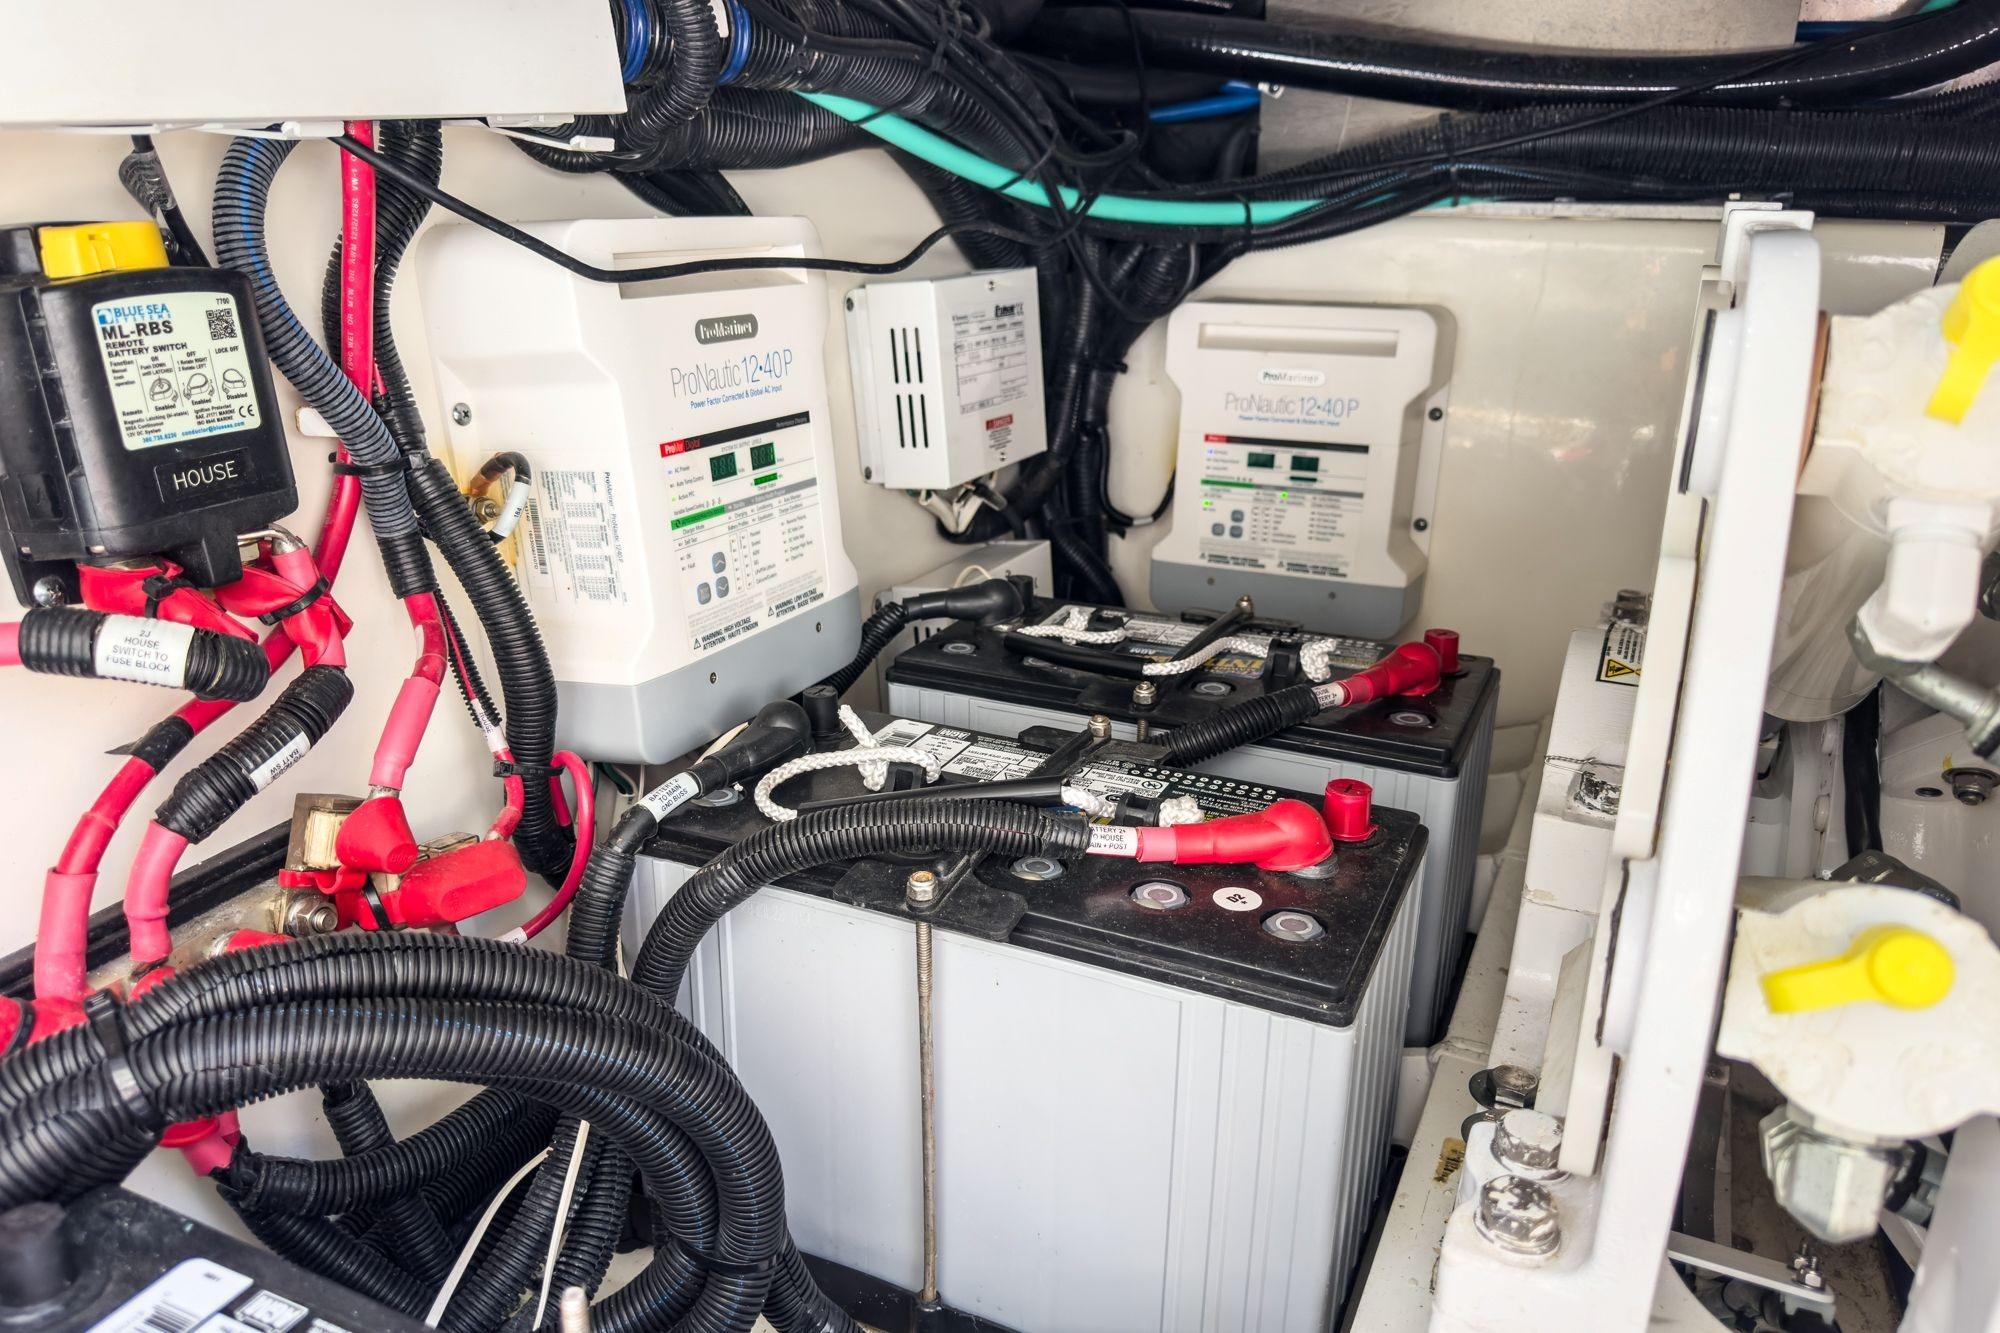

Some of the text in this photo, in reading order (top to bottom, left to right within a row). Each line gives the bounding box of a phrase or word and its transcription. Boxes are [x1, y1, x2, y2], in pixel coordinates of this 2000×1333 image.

[113, 303, 171, 317] BLUE SEA
[101, 320, 174, 340] ML-RBS
[699, 319, 752, 340] ProMariner
[105, 339, 145, 350] REMOTE
[107, 342, 188, 358] BATTERY SWITCH
[670, 359, 742, 398] ProNautic
[690, 399, 706, 409] Power
[706, 396, 722, 406] Factor
[722, 391, 745, 403] Corrected
[750, 386, 764, 397] Global
[771, 384, 783, 393] Input
[1224, 392, 1296, 416] ProNautic
[154, 404, 176, 412] Enabled
[173, 460, 239, 490] HOUSE
[802, 587, 817, 599] VOLTAGE
[809, 592, 824, 604] TENSION
[139, 629, 152, 638] 2J
[723, 624, 734, 634] HIGH
[734, 616, 752, 630] VOLTAGE
[741, 621, 759, 634] TENSION
[125, 636, 160, 649] HOUSE
[112, 644, 168, 661] SWITCH TO
[106, 655, 171, 673] FUSE BLOCK
[936, 726, 970, 741] AGM
[270, 748, 299, 775] BATT SW
[648, 781, 673, 802] BATTERY
[658, 784, 682, 803] TO MAIN
[661, 788, 688, 811] GND BUSS
[1100, 834, 1124, 842] HOUSE
